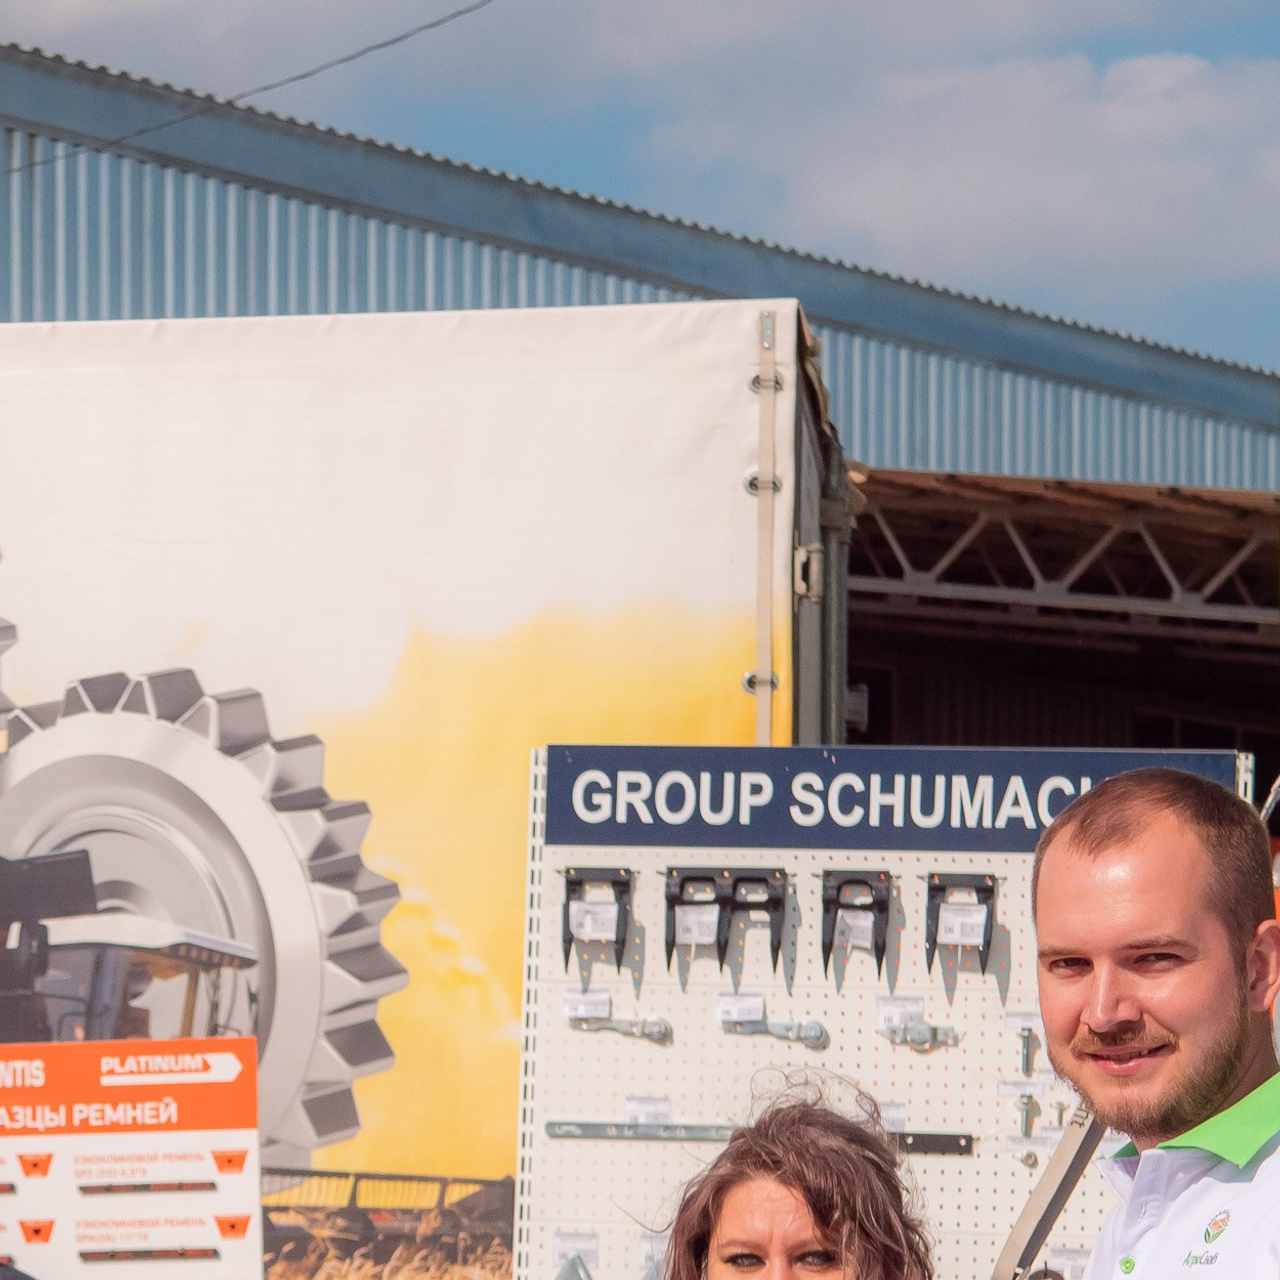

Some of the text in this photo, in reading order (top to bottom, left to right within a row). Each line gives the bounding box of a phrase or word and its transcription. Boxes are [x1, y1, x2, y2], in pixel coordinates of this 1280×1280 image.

[572, 769, 1092, 829] GROUP SCHUMAC
[100, 1053, 204, 1074] PLATINUM
[72, 1096, 179, 1127] РЕМНЕЙ
